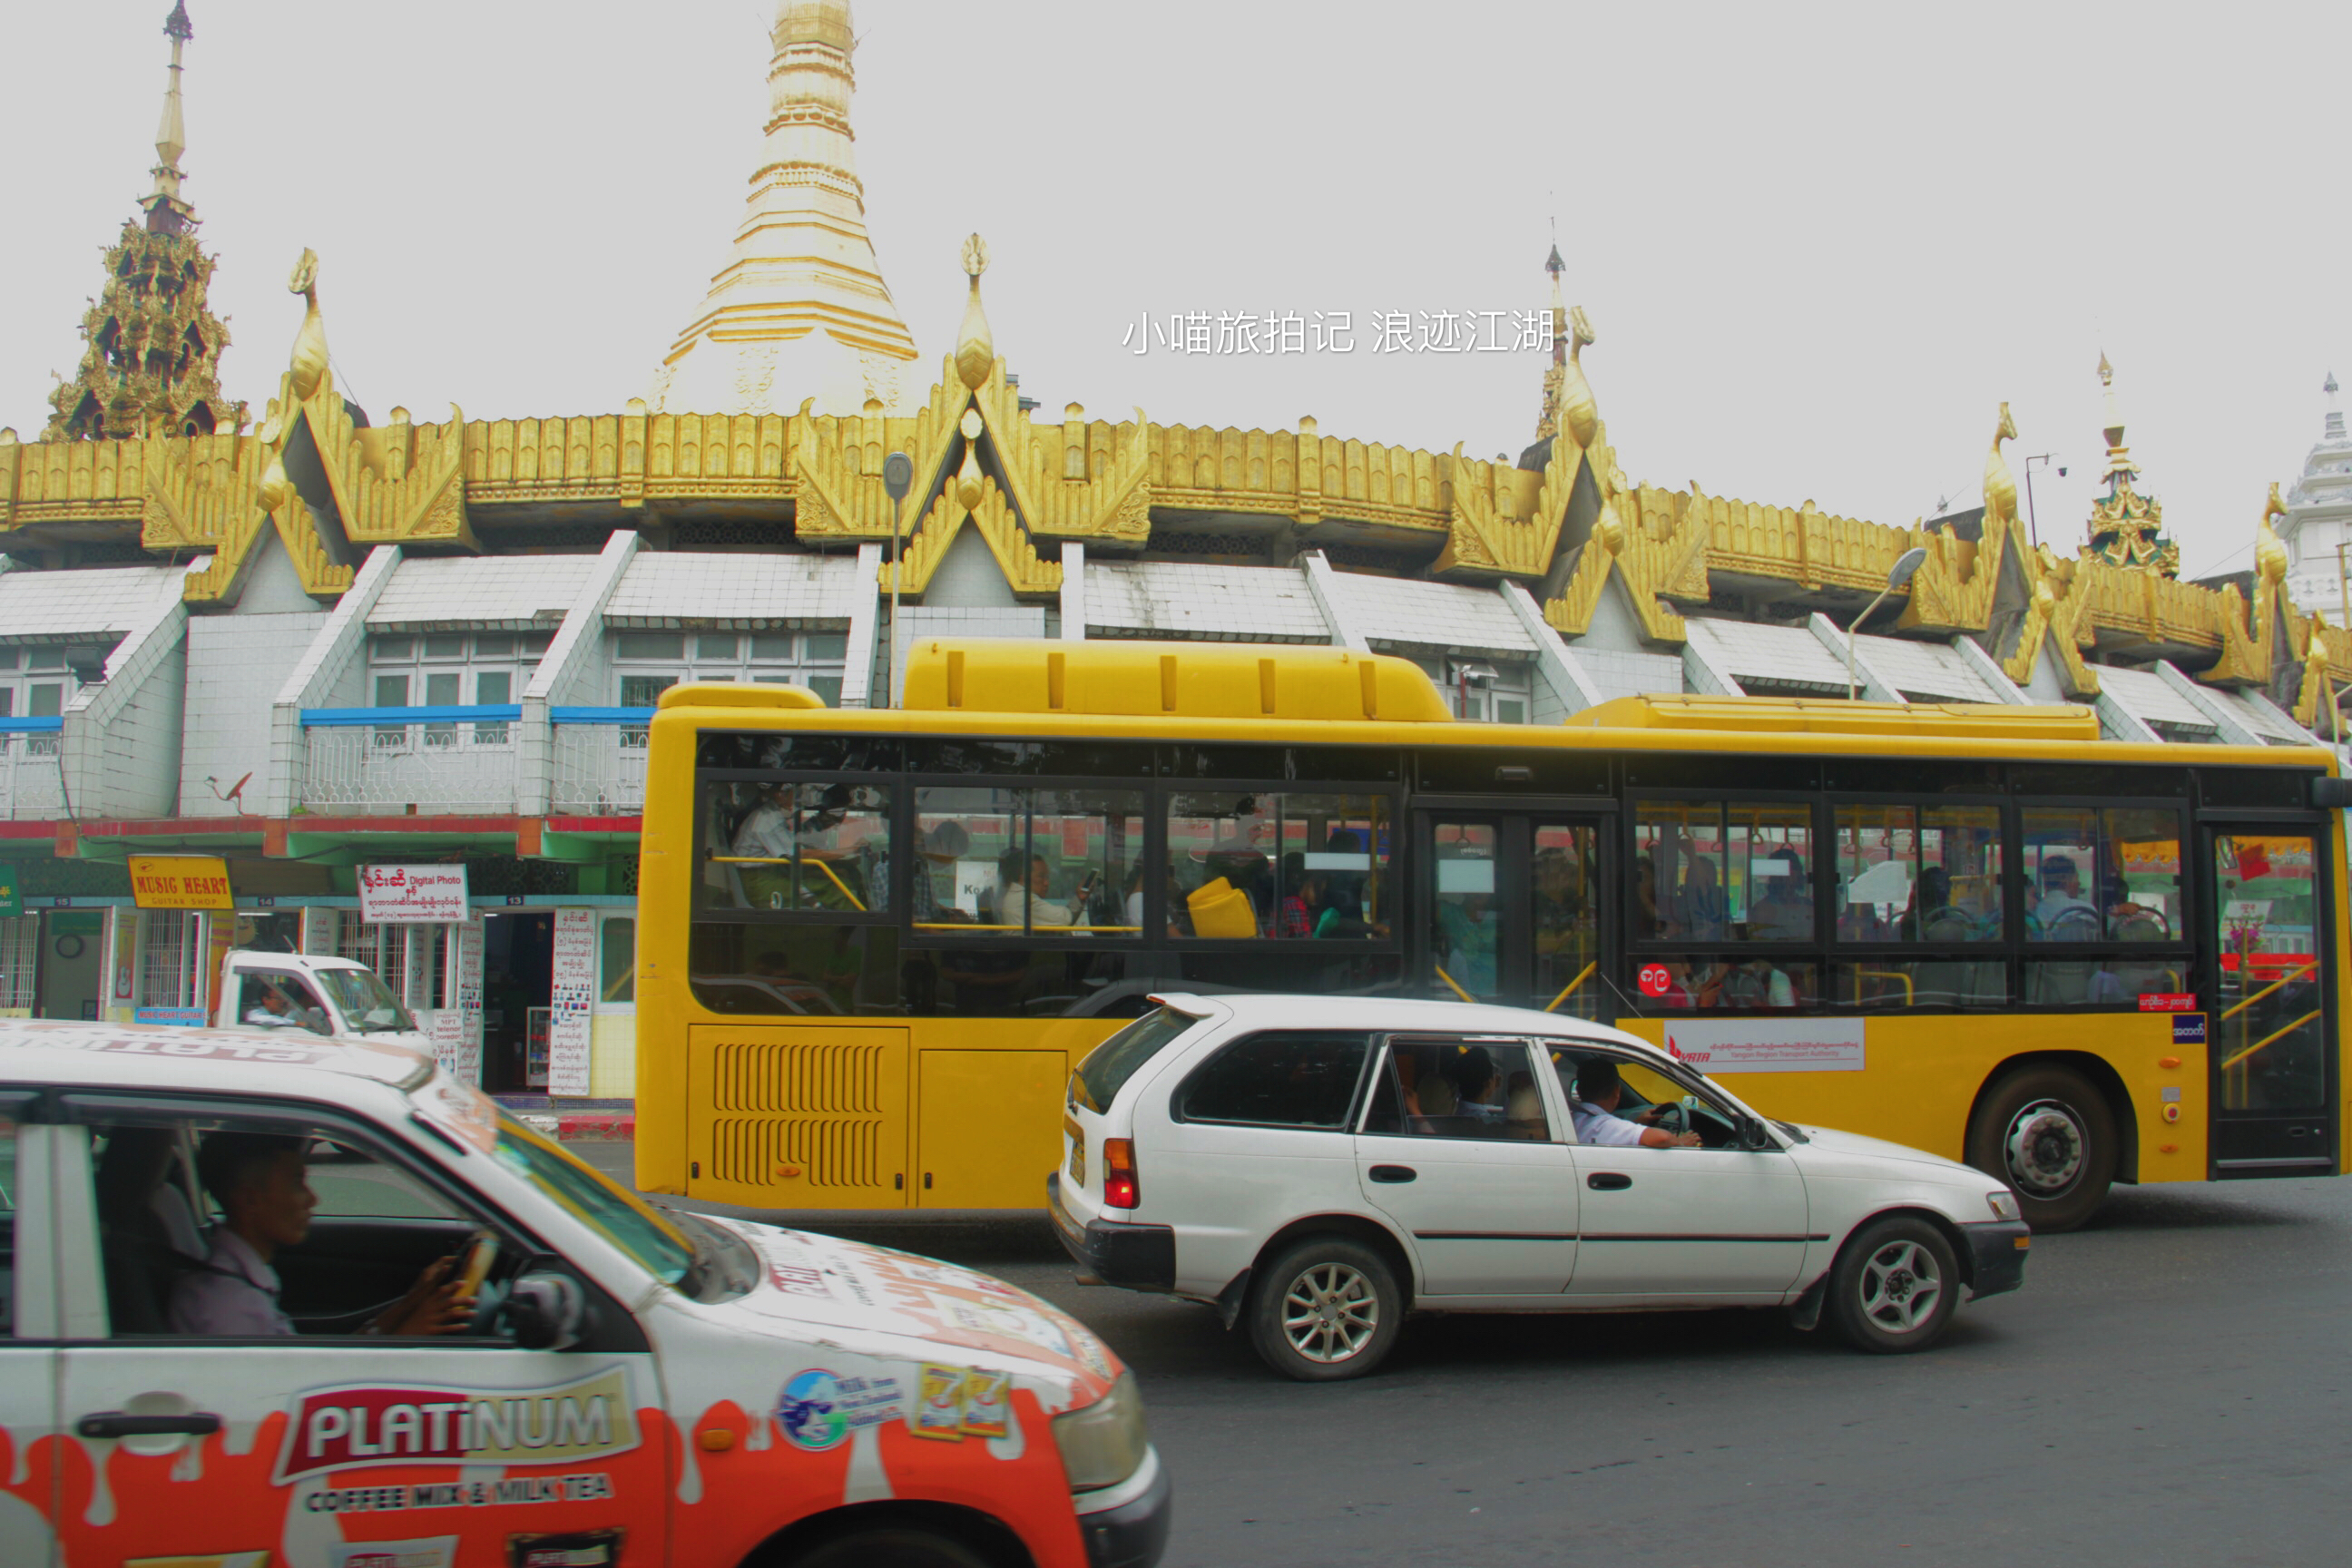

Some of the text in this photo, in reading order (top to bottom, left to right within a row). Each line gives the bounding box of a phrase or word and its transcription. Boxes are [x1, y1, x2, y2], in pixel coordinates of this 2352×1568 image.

[136, 877, 228, 895] MUSIC HEART
[409, 876, 461, 887] Digital Photo
[55, 897, 69, 906] 15
[191, 897, 217, 906] SHOP
[1682, 1052, 1710, 1063] YRTA
[1730, 1052, 1755, 1060] Yangon
[1756, 1051, 1778, 1059] Region
[1779, 1050, 1809, 1058] Transport
[307, 1474, 613, 1513] COFFEE MIX & MILK TEA
